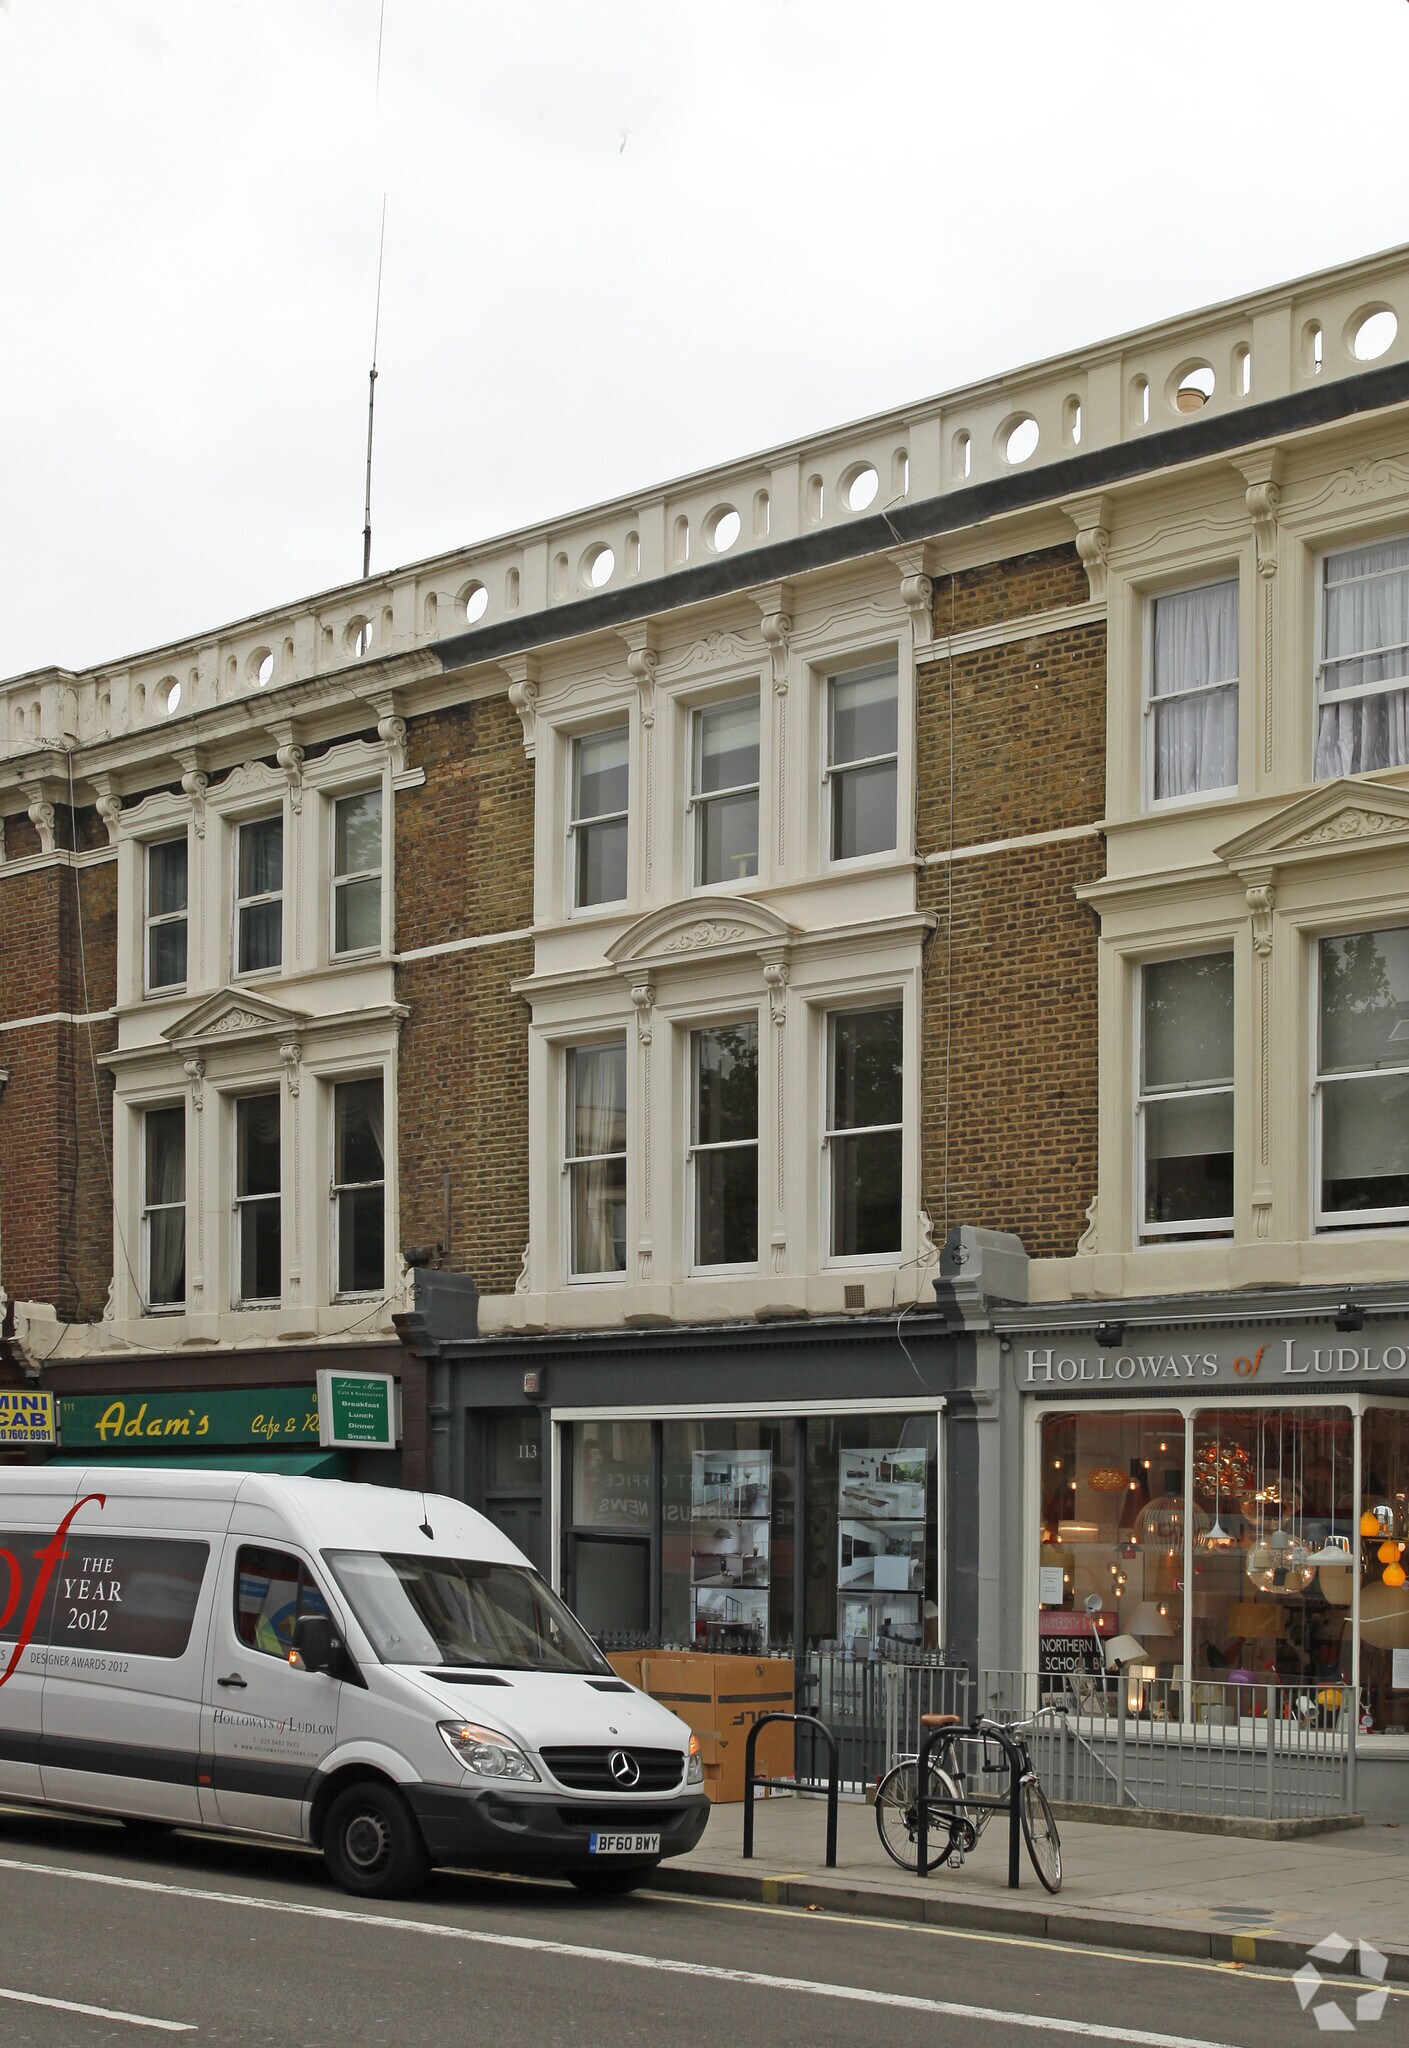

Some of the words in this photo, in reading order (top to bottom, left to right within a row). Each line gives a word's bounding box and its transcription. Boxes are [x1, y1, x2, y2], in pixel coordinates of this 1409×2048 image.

[1024, 1349, 1218, 1382] HOLLOWAYS
[1233, 1344, 1270, 1378] of
[1281, 1338, 1409, 1374] LUDLO
[341, 1400, 380, 1409] Breakfast
[348, 1411, 374, 1419] Lunch
[251, 1414, 280, 1440] Cafe
[284, 1417, 296, 1433] &
[348, 1422, 375, 1430] Dinner
[8, 1429, 28, 1440] 7602
[30, 1430, 51, 1441] 9991
[347, 1433, 377, 1441] Snacks
[518, 1444, 537, 1459] 113
[82, 1557, 114, 1574] THE
[64, 1578, 122, 1602] YEAR
[67, 1607, 109, 1631] 2012
[1040, 1616, 1080, 1631] HAMMERSMITH
[1041, 1638, 1093, 1653] NORTHERN
[30, 1652, 70, 1667] DESIGNER
[70, 1656, 107, 1671] AWARDS
[108, 1660, 129, 1673] 2012
[1045, 1656, 1090, 1671] SCHOOL
[213, 1709, 275, 1730] HOLLOWAYS
[276, 1717, 288, 1735] of
[288, 1716, 336, 1735] LUDLOW
[598, 1836, 632, 1851] BF60
[635, 1836, 658, 1851] BWY
